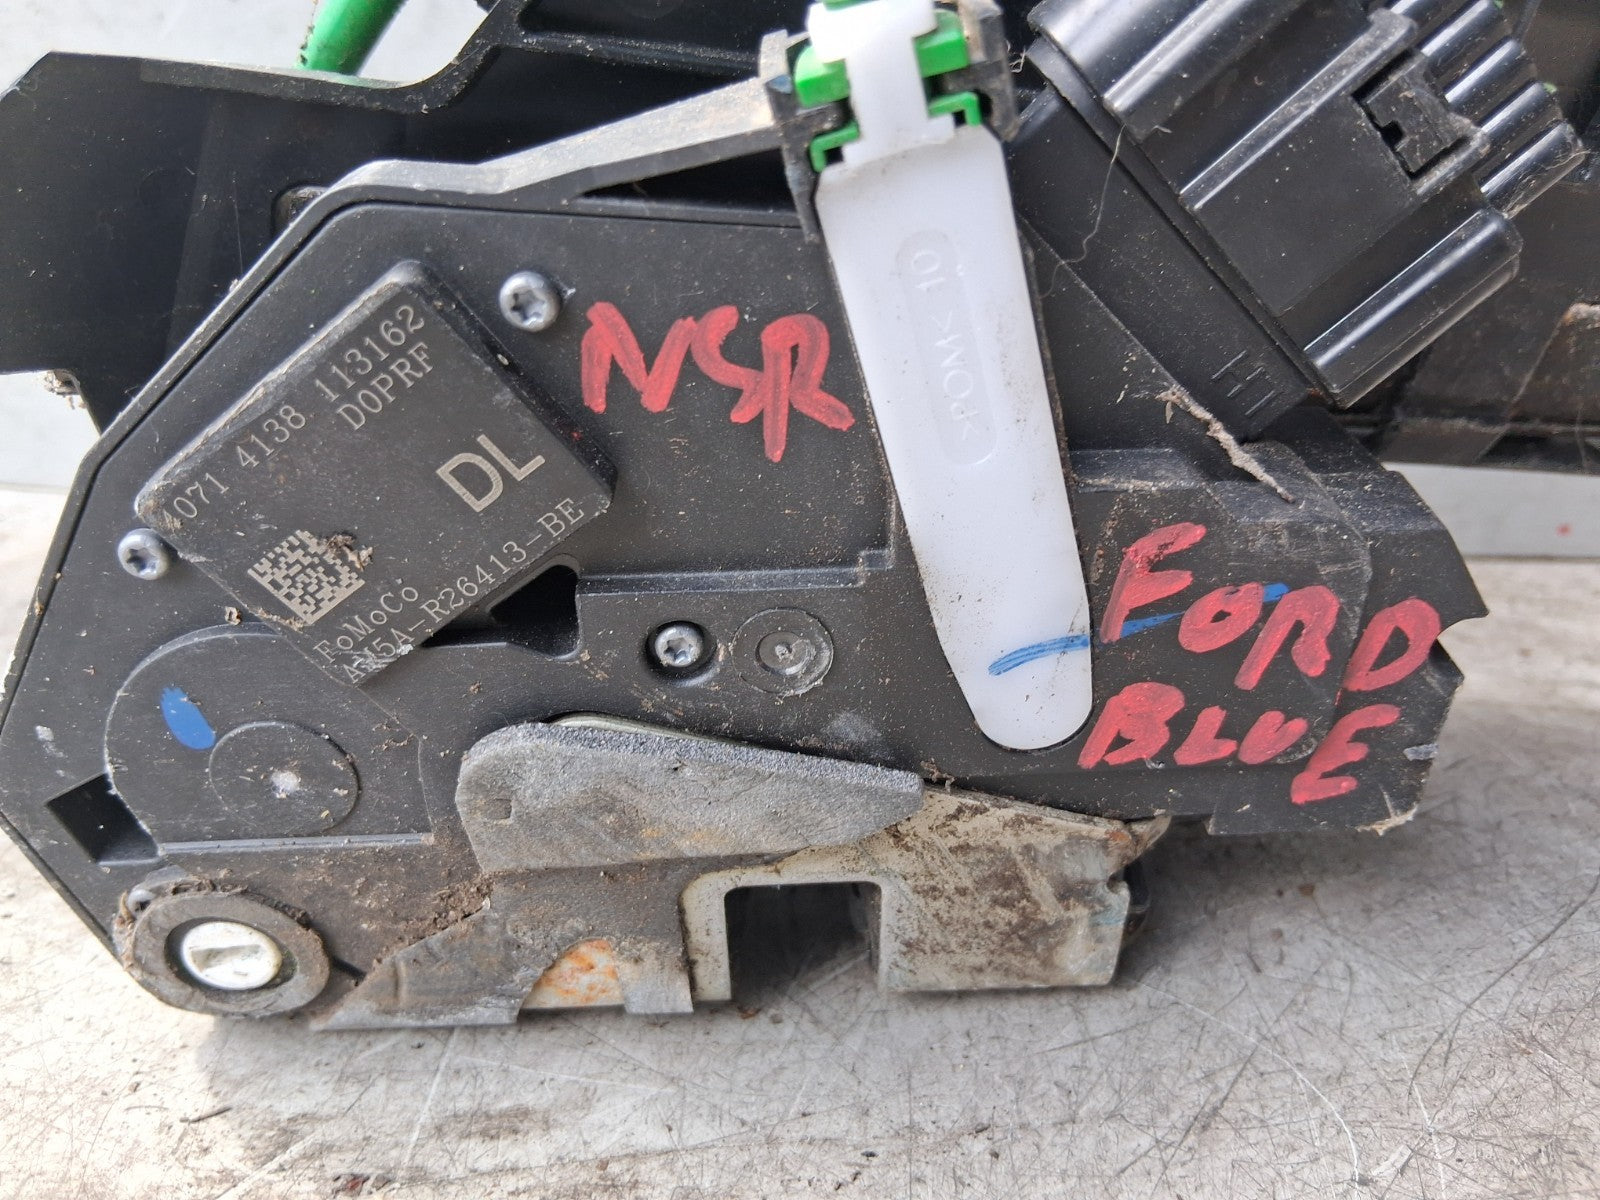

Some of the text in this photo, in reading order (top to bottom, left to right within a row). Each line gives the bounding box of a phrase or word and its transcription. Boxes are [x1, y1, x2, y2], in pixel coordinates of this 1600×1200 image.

[235, 404, 307, 469] 4138
[314, 304, 426, 403] 113162
[581, 301, 856, 463] NSR
[435, 433, 546, 513] DL
[312, 586, 419, 664] FoMoCo
[1099, 521, 1442, 692] FORD
[1076, 681, 1401, 805] BLUE
